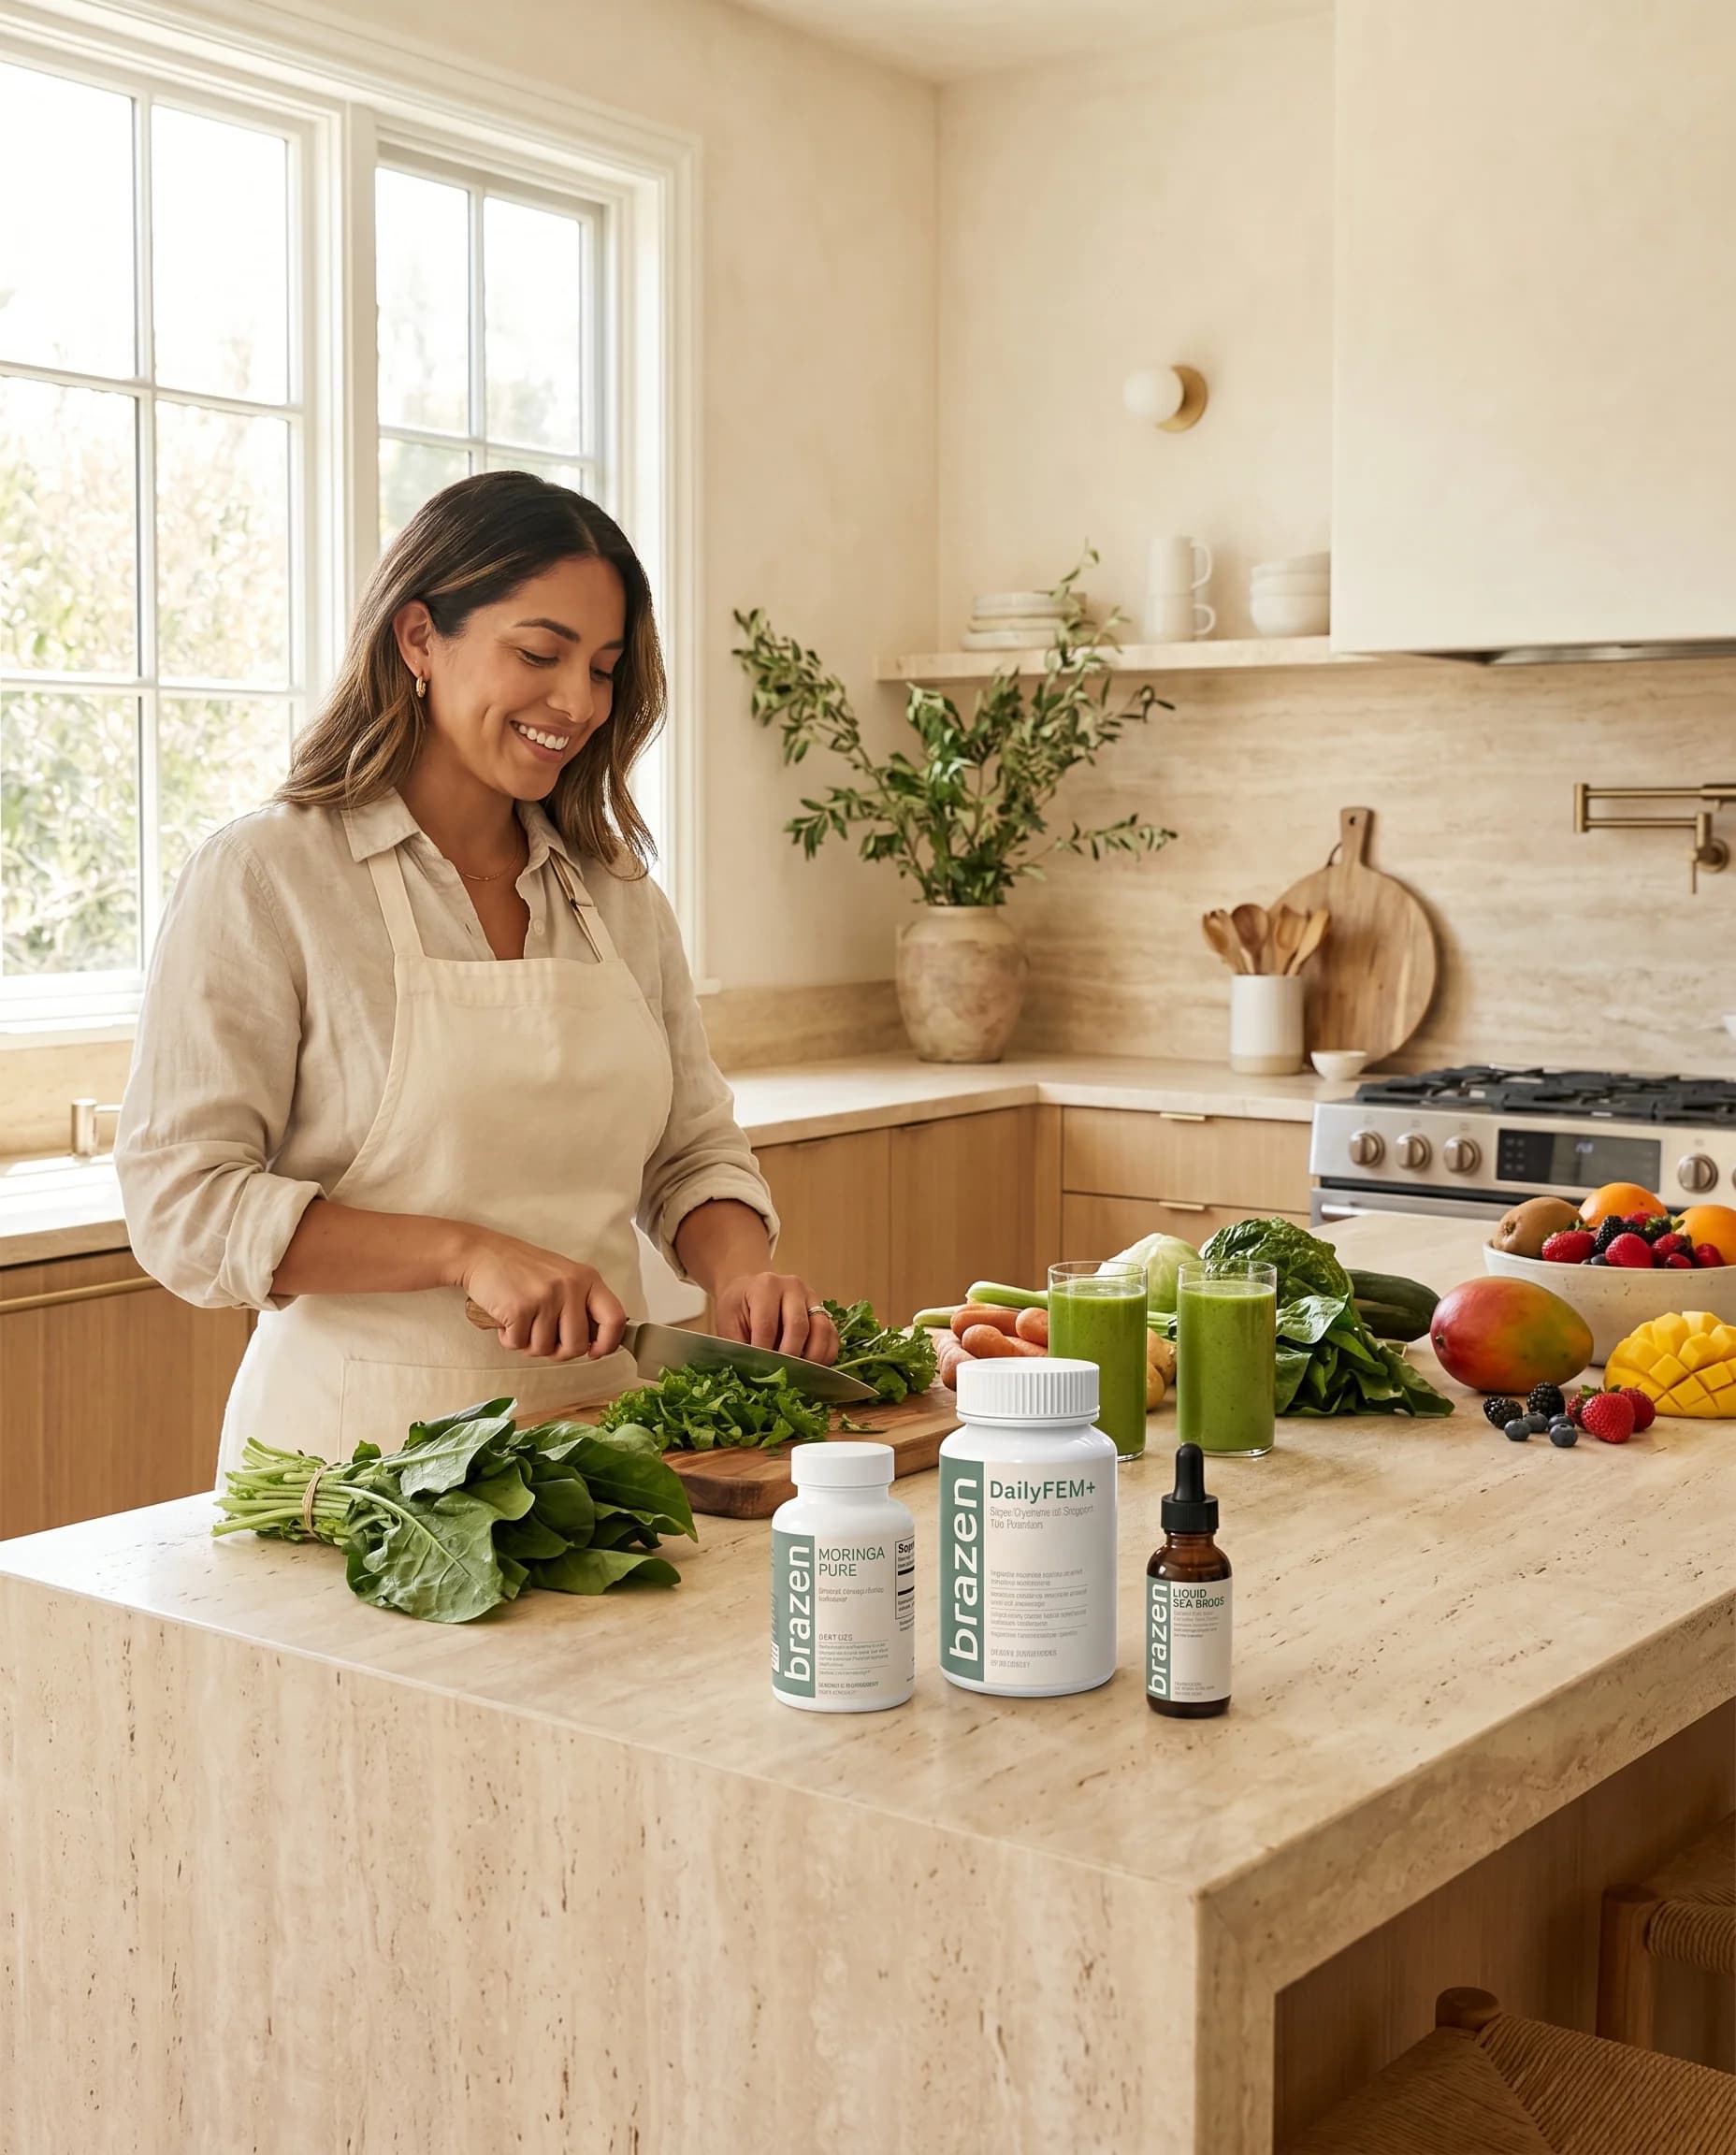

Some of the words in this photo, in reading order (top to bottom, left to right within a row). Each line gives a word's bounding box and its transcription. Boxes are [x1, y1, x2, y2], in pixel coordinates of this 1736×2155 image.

[990, 1479, 1095, 1504] DailyFEM+
[818, 1546, 885, 1561] MORINGA
[818, 1563, 857, 1576] PURE
[949, 1478, 977, 1661] brazen
[1173, 1588, 1207, 1598] LIQUID
[784, 1545, 811, 1682] brazen
[1173, 1598, 1193, 1609] SEA
[1148, 1584, 1167, 1695] brazen
